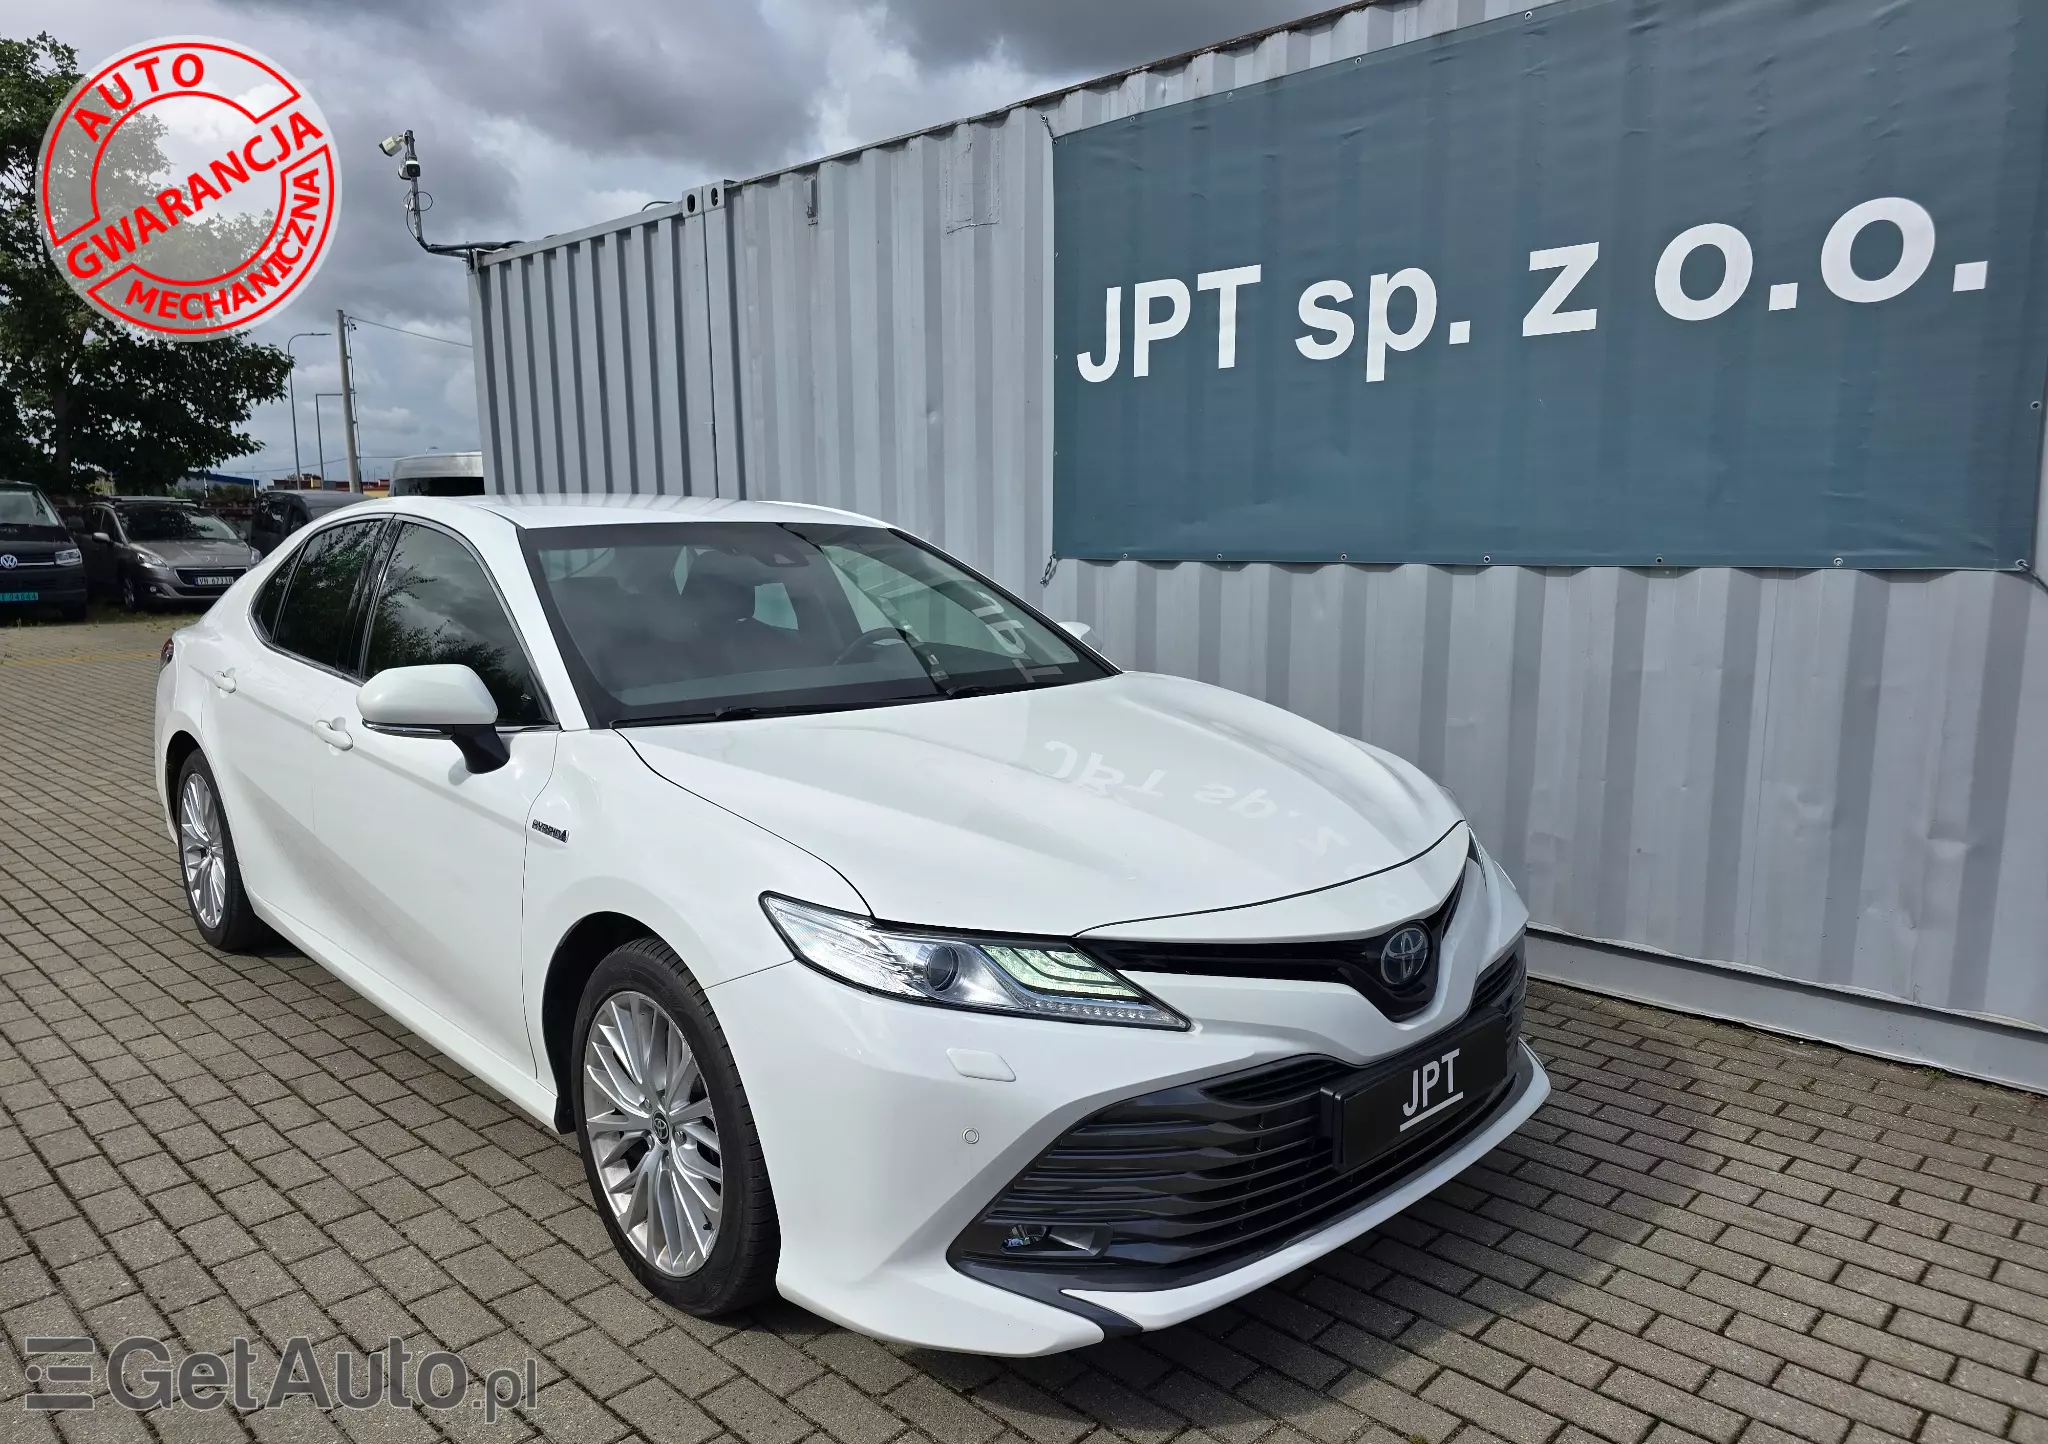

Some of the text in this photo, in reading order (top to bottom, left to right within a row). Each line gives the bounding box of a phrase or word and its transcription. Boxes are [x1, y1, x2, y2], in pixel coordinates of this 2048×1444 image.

[1076, 196, 1990, 384] JPT sp. z o.o.
[1402, 1048, 1460, 1117] JPT
